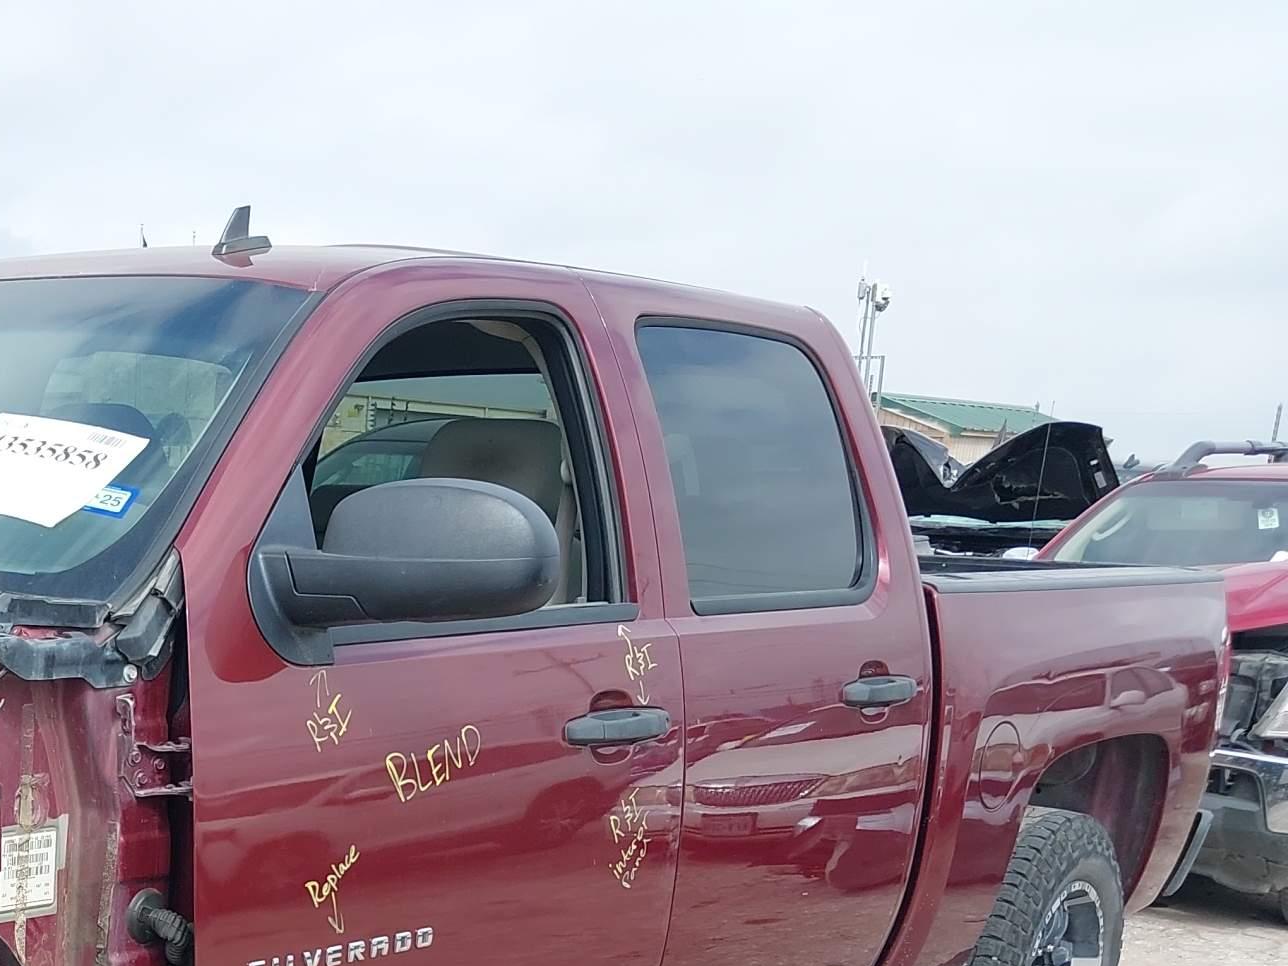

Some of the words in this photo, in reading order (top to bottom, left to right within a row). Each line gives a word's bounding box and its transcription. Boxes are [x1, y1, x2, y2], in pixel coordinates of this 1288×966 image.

[99, 494, 122, 507] 25
[385, 724, 481, 803] BLEND
[304, 844, 361, 908] Replace
